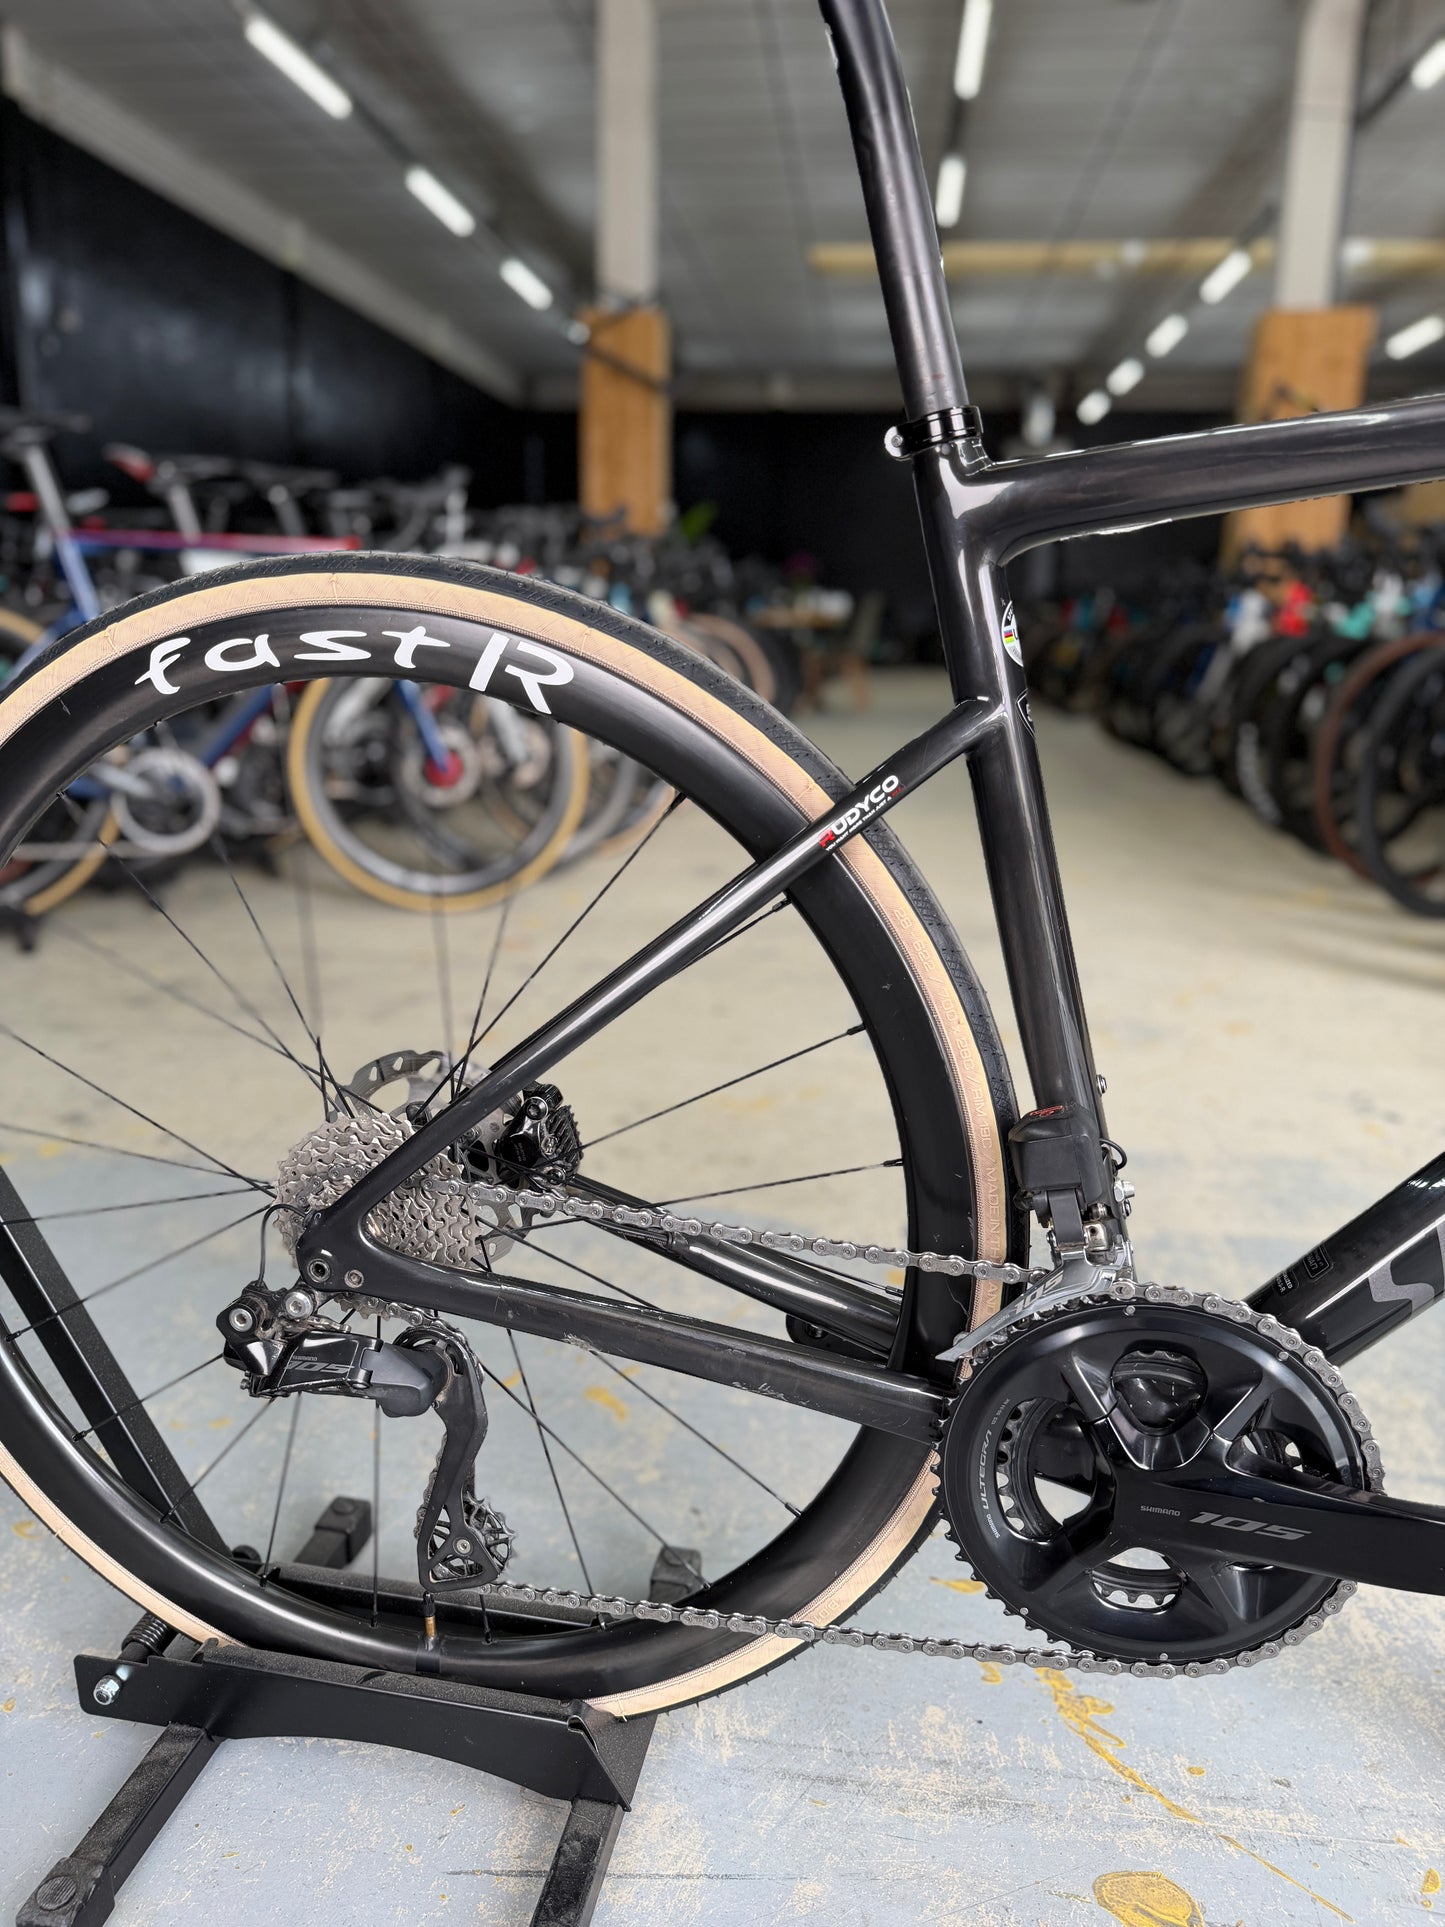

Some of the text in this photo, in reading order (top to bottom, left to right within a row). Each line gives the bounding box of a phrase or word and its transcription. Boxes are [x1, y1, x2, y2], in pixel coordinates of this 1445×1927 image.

[818, 775, 899, 848] RUDYCO
[985, 1167, 1000, 1216] MADE
[989, 1219, 1001, 1233] IN
[1014, 1270, 1064, 1315] 105
[283, 1360, 355, 1374] 105
[979, 1429, 992, 1510] ULTEGRA
[1140, 1505, 1312, 1541] SHIMANO 105
